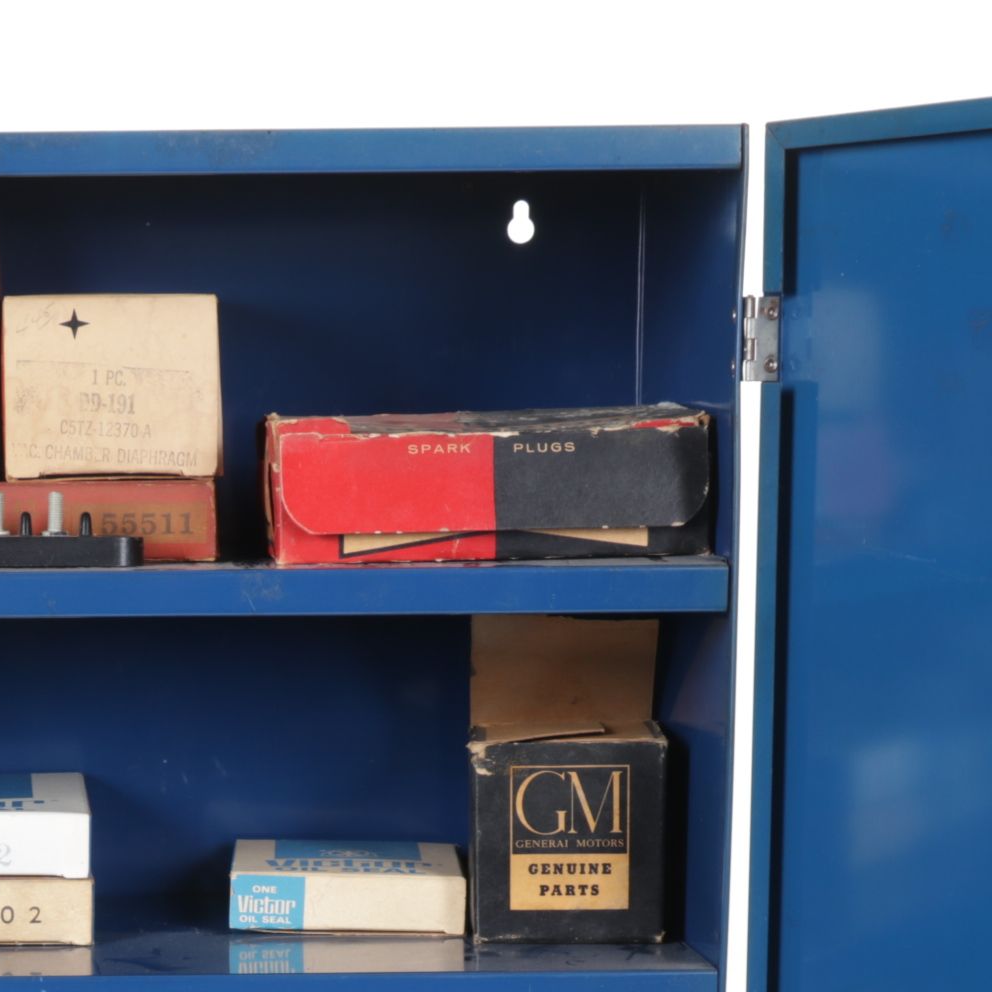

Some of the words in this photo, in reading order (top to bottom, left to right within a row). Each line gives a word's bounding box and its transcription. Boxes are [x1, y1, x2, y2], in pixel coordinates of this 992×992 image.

[91, 370, 99, 386] 1
[407, 443, 472, 455] SPARK
[513, 441, 576, 454] PLUGS
[100, 511, 194, 535] 55511
[514, 769, 624, 837] GM
[515, 838, 569, 849] GENERAL
[575, 838, 625, 849] MOTORS
[527, 862, 613, 876] GENUINE
[252, 885, 278, 894] ONE
[539, 883, 601, 897] PARTS
[236, 895, 296, 915] Victor
[239, 915, 259, 924] OIL
[262, 915, 292, 925] SEAL
